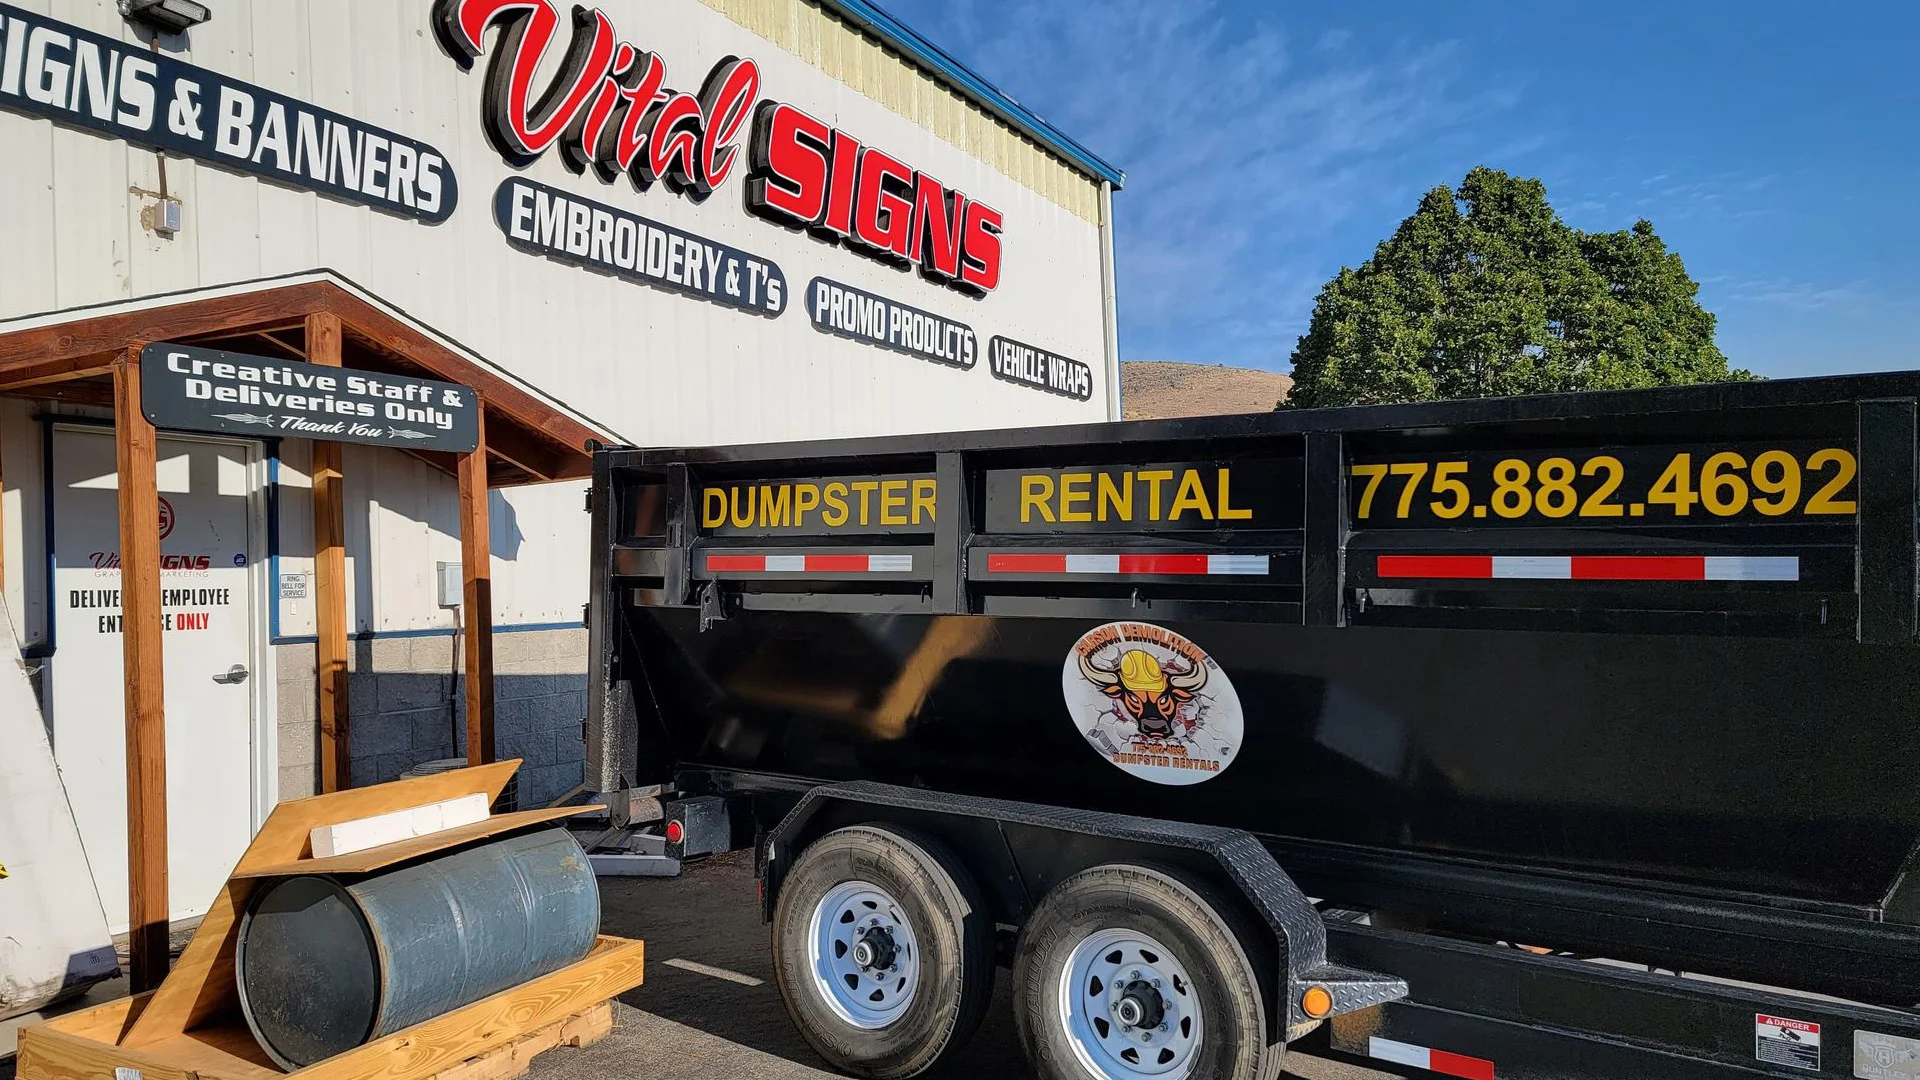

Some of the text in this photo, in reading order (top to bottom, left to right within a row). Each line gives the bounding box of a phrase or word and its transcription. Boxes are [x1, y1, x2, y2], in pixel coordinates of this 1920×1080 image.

[0, 14, 443, 214] IGNS & BANNERS
[459, 0, 761, 192] Vital
[764, 103, 1003, 293] SIGNS
[510, 183, 723, 294] EMBROIDERY
[725, 258, 741, 298] &
[815, 281, 974, 365] PROMO PRODUCTS
[167, 352, 464, 408] Creative Staff &
[993, 338, 1089, 396] VEHICLE WRAPS
[185, 378, 453, 430] Deliveries Only
[280, 415, 383, 439] Thank You
[702, 448, 1857, 529] DUMPSTER RENTAL 775.882.4692
[70, 588, 229, 608] DELIVE EMPLOYEE
[177, 613, 209, 630] ONLY
[1075, 624, 1206, 663] CARSON DEMOLITION
[1113, 752, 1220, 771] DUMPSTER RENTALS
[1774, 1019, 1810, 1031] DANGER
